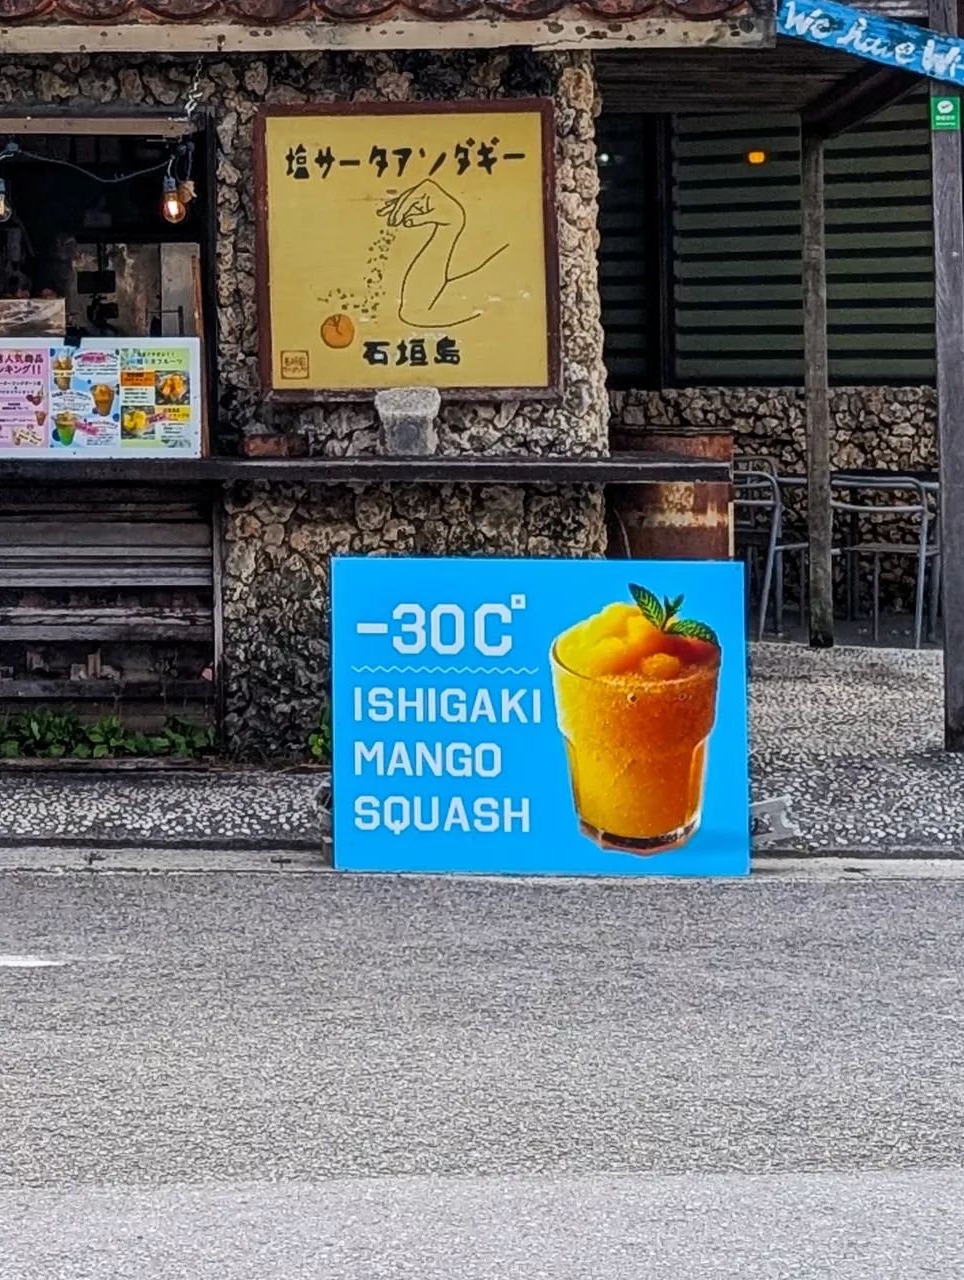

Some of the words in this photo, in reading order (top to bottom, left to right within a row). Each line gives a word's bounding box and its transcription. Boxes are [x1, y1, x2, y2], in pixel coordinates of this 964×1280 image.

[784, 1, 833, 40] We
[836, 18, 916, 65] have
[285, 137, 526, 180] 塩サータアンダギー
[363, 336, 461, 366] 石垣島
[353, 687, 542, 724] ISHIGAKI
[354, 741, 502, 777] MANGO
[353, 795, 531, 835] SQUASH
